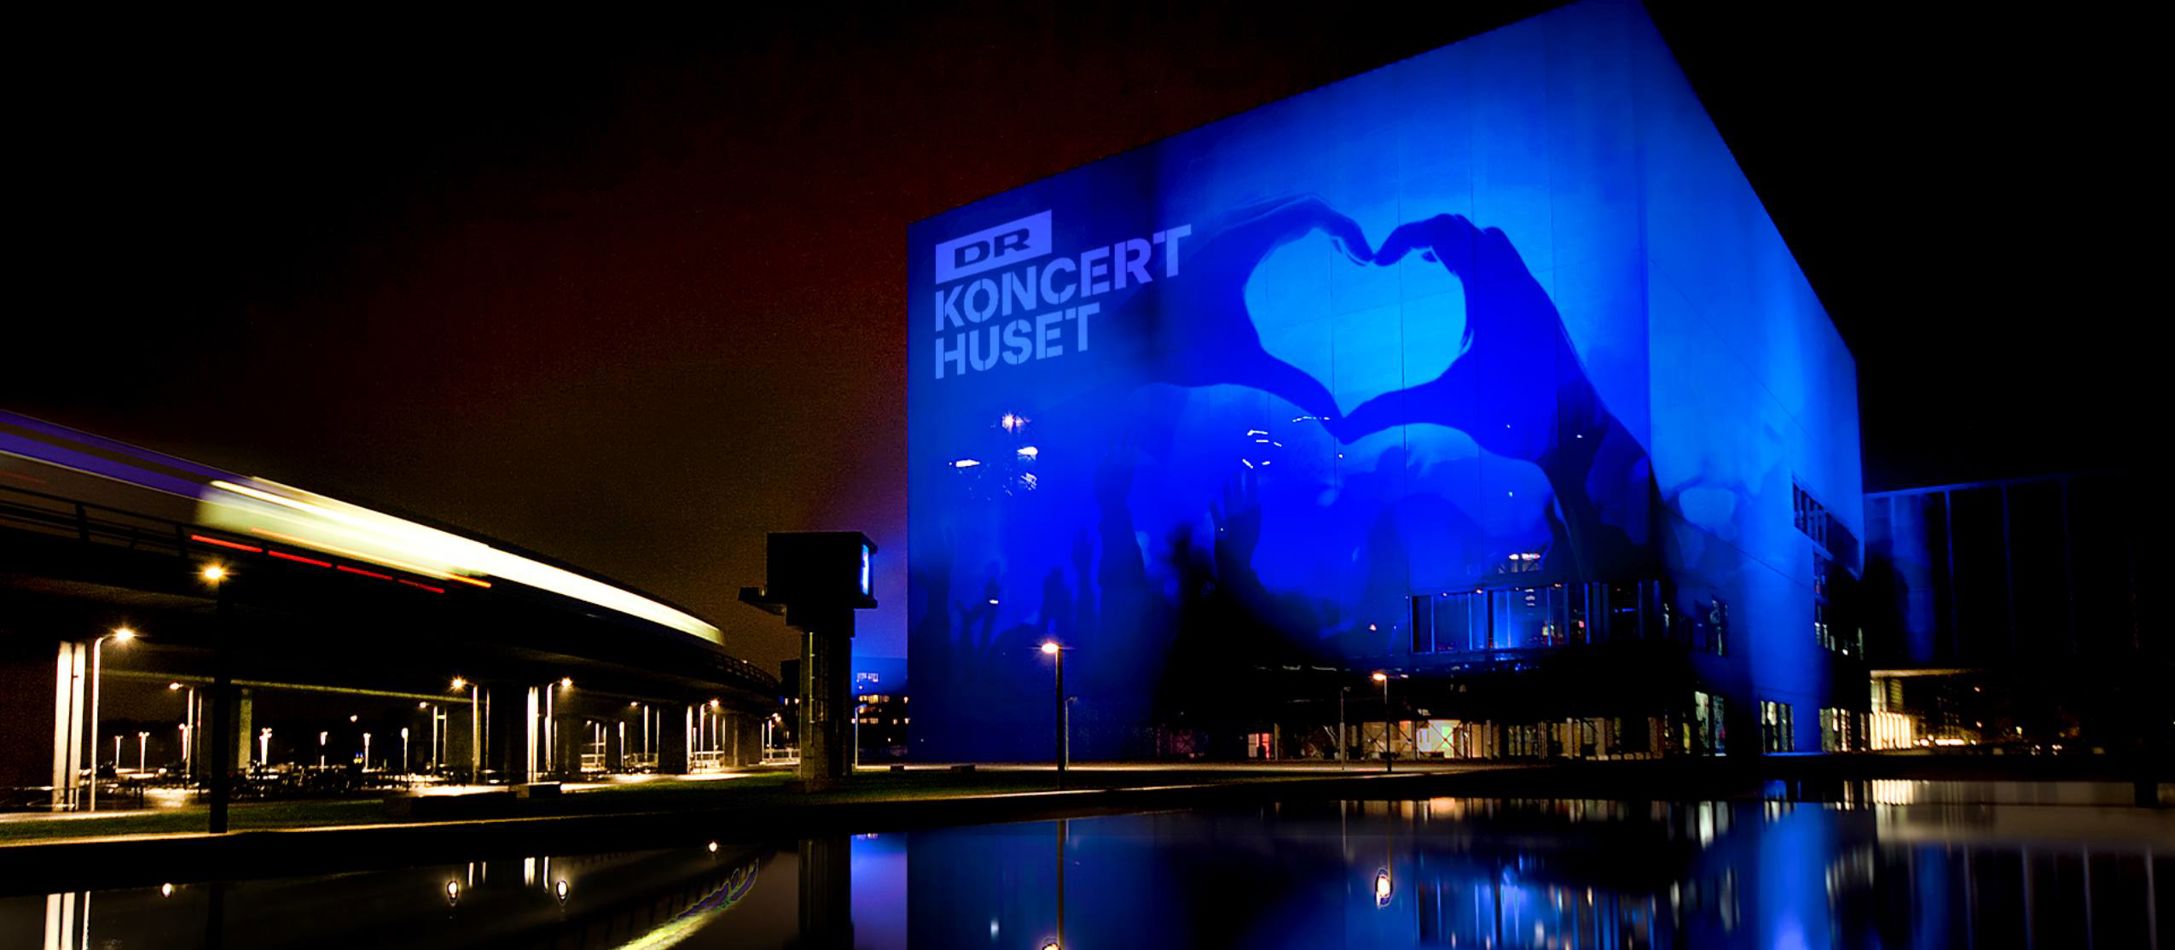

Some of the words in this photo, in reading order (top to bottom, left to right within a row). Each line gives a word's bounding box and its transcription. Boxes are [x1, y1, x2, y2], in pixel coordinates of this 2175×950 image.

[935, 224, 1191, 332] KONCERT
[954, 228, 1031, 269] DR
[935, 302, 1100, 379] HUSET
